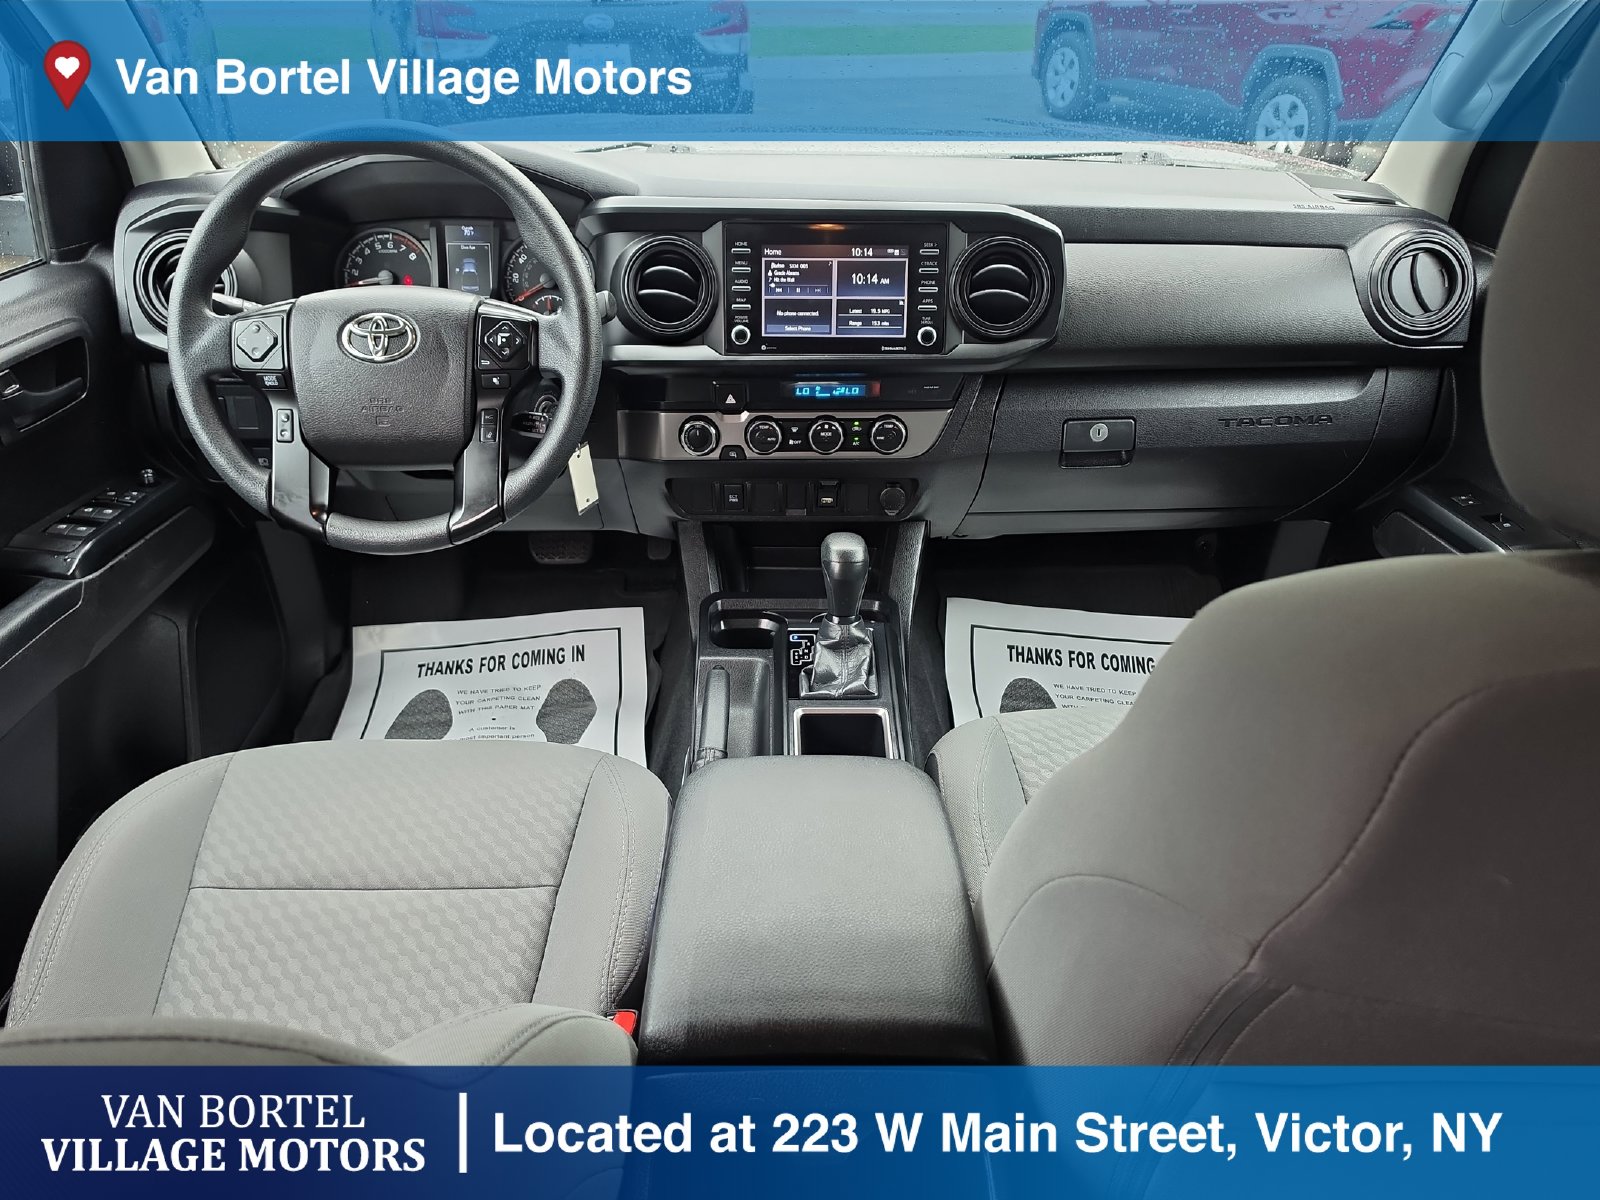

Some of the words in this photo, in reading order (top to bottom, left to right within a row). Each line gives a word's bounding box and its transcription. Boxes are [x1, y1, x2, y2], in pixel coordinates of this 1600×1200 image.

[374, 242, 382, 250] 5
[387, 241, 394, 249] 6
[399, 244, 407, 252] 7
[408, 252, 417, 261] 8
[763, 248, 782, 256] Home
[851, 247, 873, 257] 10:14
[356, 256, 363, 265] 3
[518, 253, 528, 265] 40
[351, 268, 359, 276] 2
[512, 272, 519, 283] 20
[851, 272, 879, 285] 10:14
[879, 277, 890, 285] AM
[1218, 414, 1334, 428] TACOMA
[417, 658, 473, 678] THANKS
[479, 655, 506, 674] FOR
[511, 647, 566, 669] COMING
[571, 644, 586, 662] IN
[1006, 644, 1063, 667] THANKS
[1068, 650, 1096, 670] FOR
[1101, 653, 1156, 676] COMING
[478, 695, 516, 703] CARPETING
[1076, 696, 1115, 704] CARPETING
